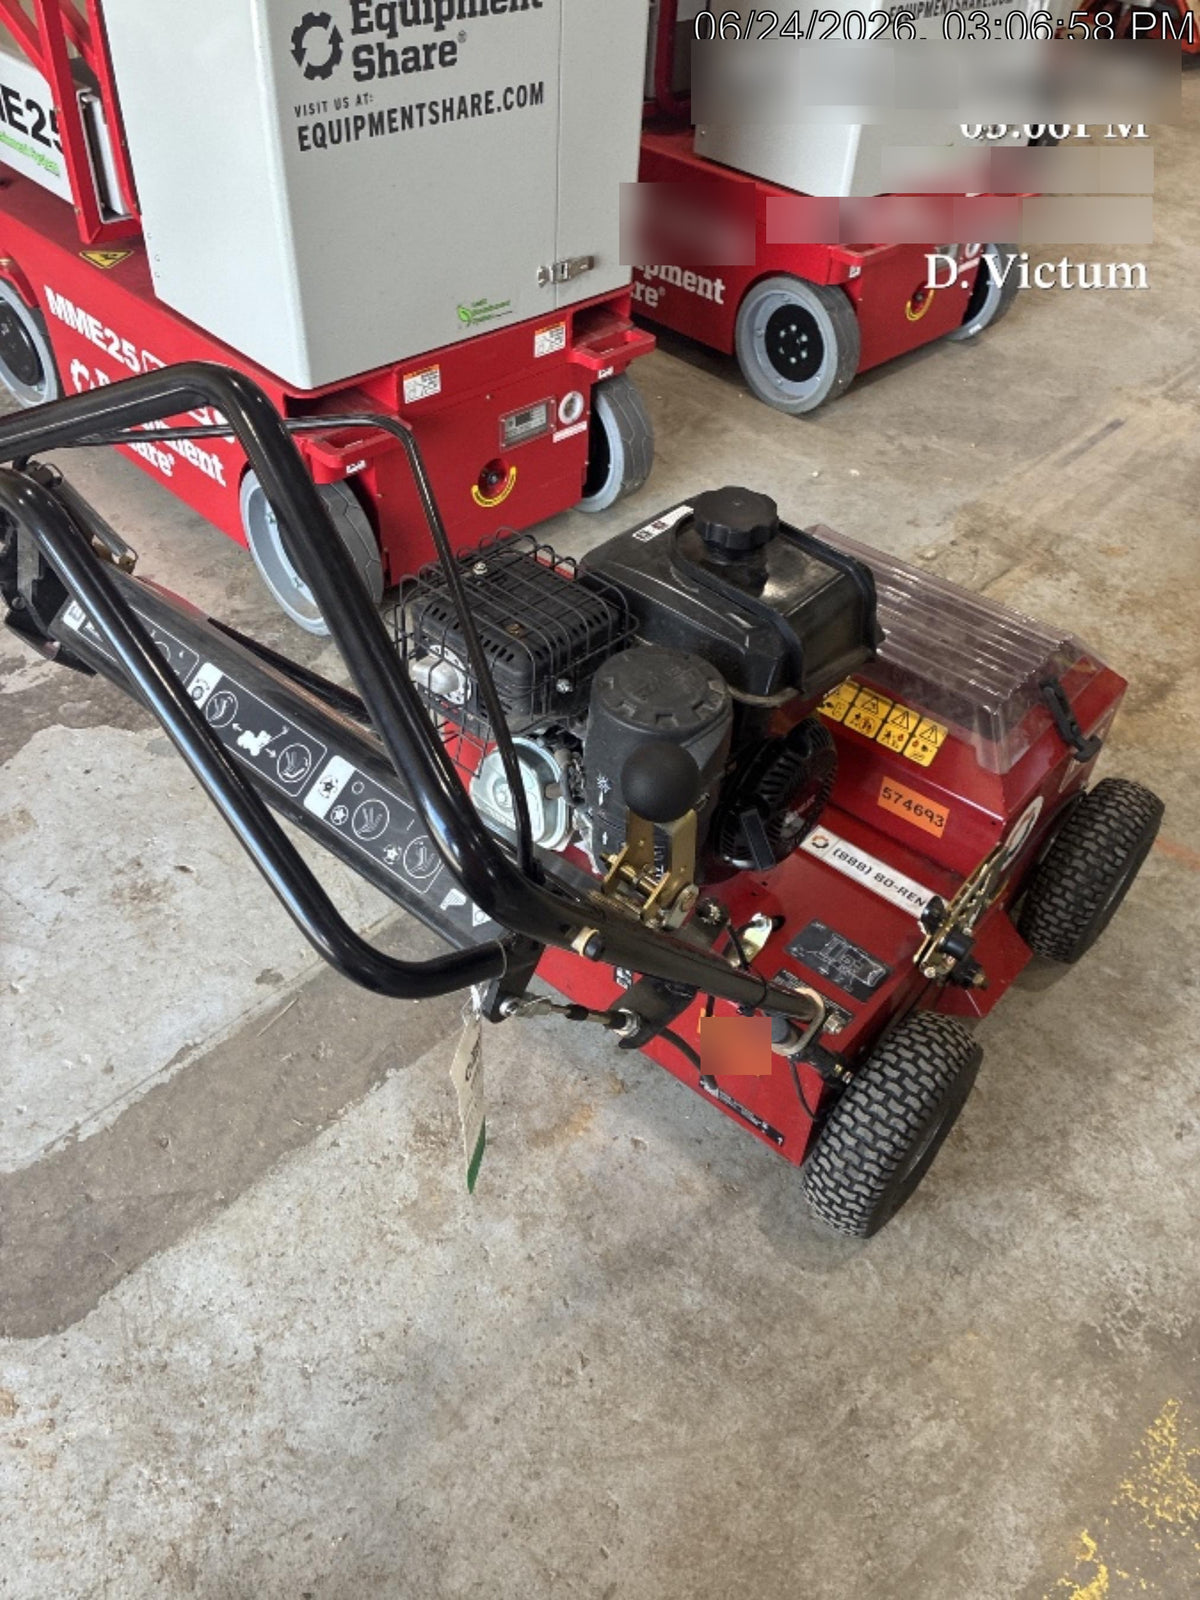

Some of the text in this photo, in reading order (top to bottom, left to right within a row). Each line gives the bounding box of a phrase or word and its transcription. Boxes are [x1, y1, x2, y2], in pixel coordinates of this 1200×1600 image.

[350, 0, 543, 39] Equipme
[294, 92, 374, 118] VISIT US AT:
[297, 81, 545, 152] EQUIPMENTSHARE.COM
[44, 284, 141, 376] MME25
[881, 786, 945, 828] 574693
[832, 848, 926, 908] (888) 80-REN
